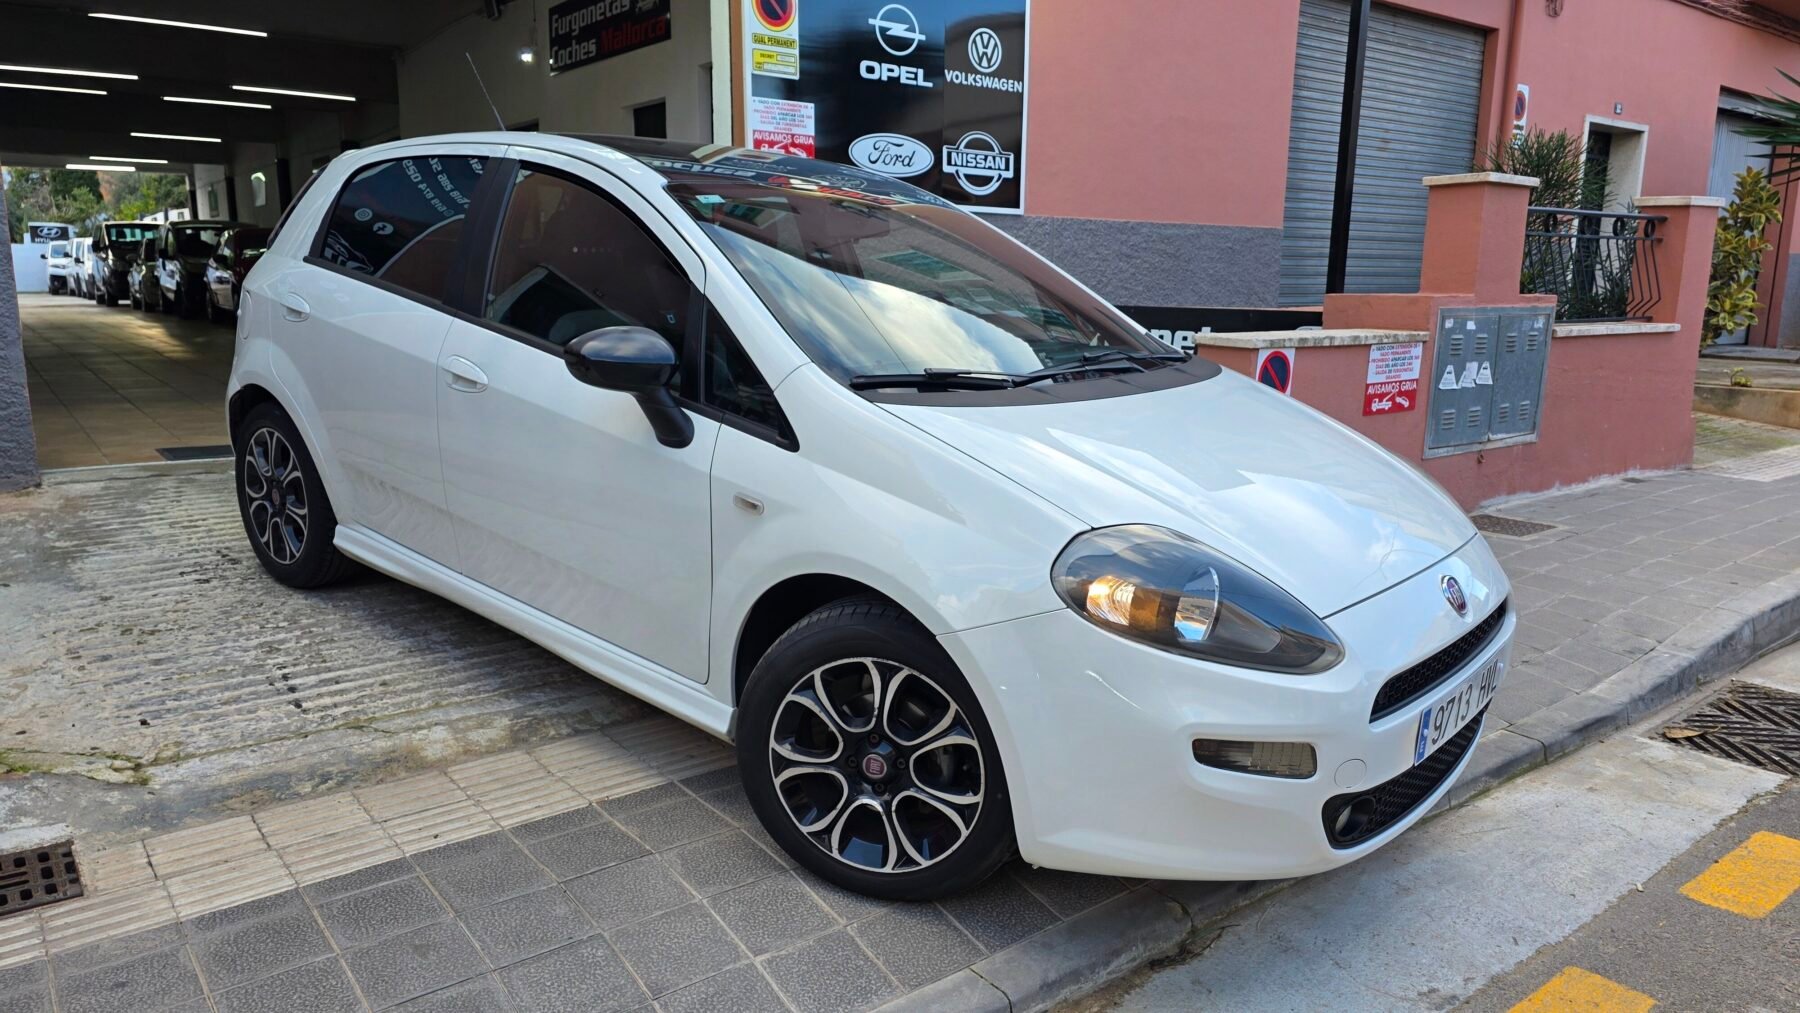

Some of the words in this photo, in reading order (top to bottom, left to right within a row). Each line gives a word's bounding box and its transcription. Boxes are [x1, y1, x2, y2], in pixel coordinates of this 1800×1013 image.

[552, 0, 630, 37] Furgonetas
[551, 38, 597, 69] Coches
[600, 15, 667, 54] Mallorca
[767, 37, 795, 48] PERMANENT
[859, 59, 933, 88] OPEL
[944, 69, 1023, 94] VOLKSWAGEN
[754, 131, 792, 143] AVISAMOS
[793, 135, 814, 145] GRUA
[867, 138, 916, 168] Ford
[950, 150, 1006, 170] NISSAN
[1367, 383, 1399, 394] AVISAMOS
[1400, 380, 1417, 392] GRUA
[1431, 683, 1473, 745] 9713
[1477, 658, 1499, 708] HVL
